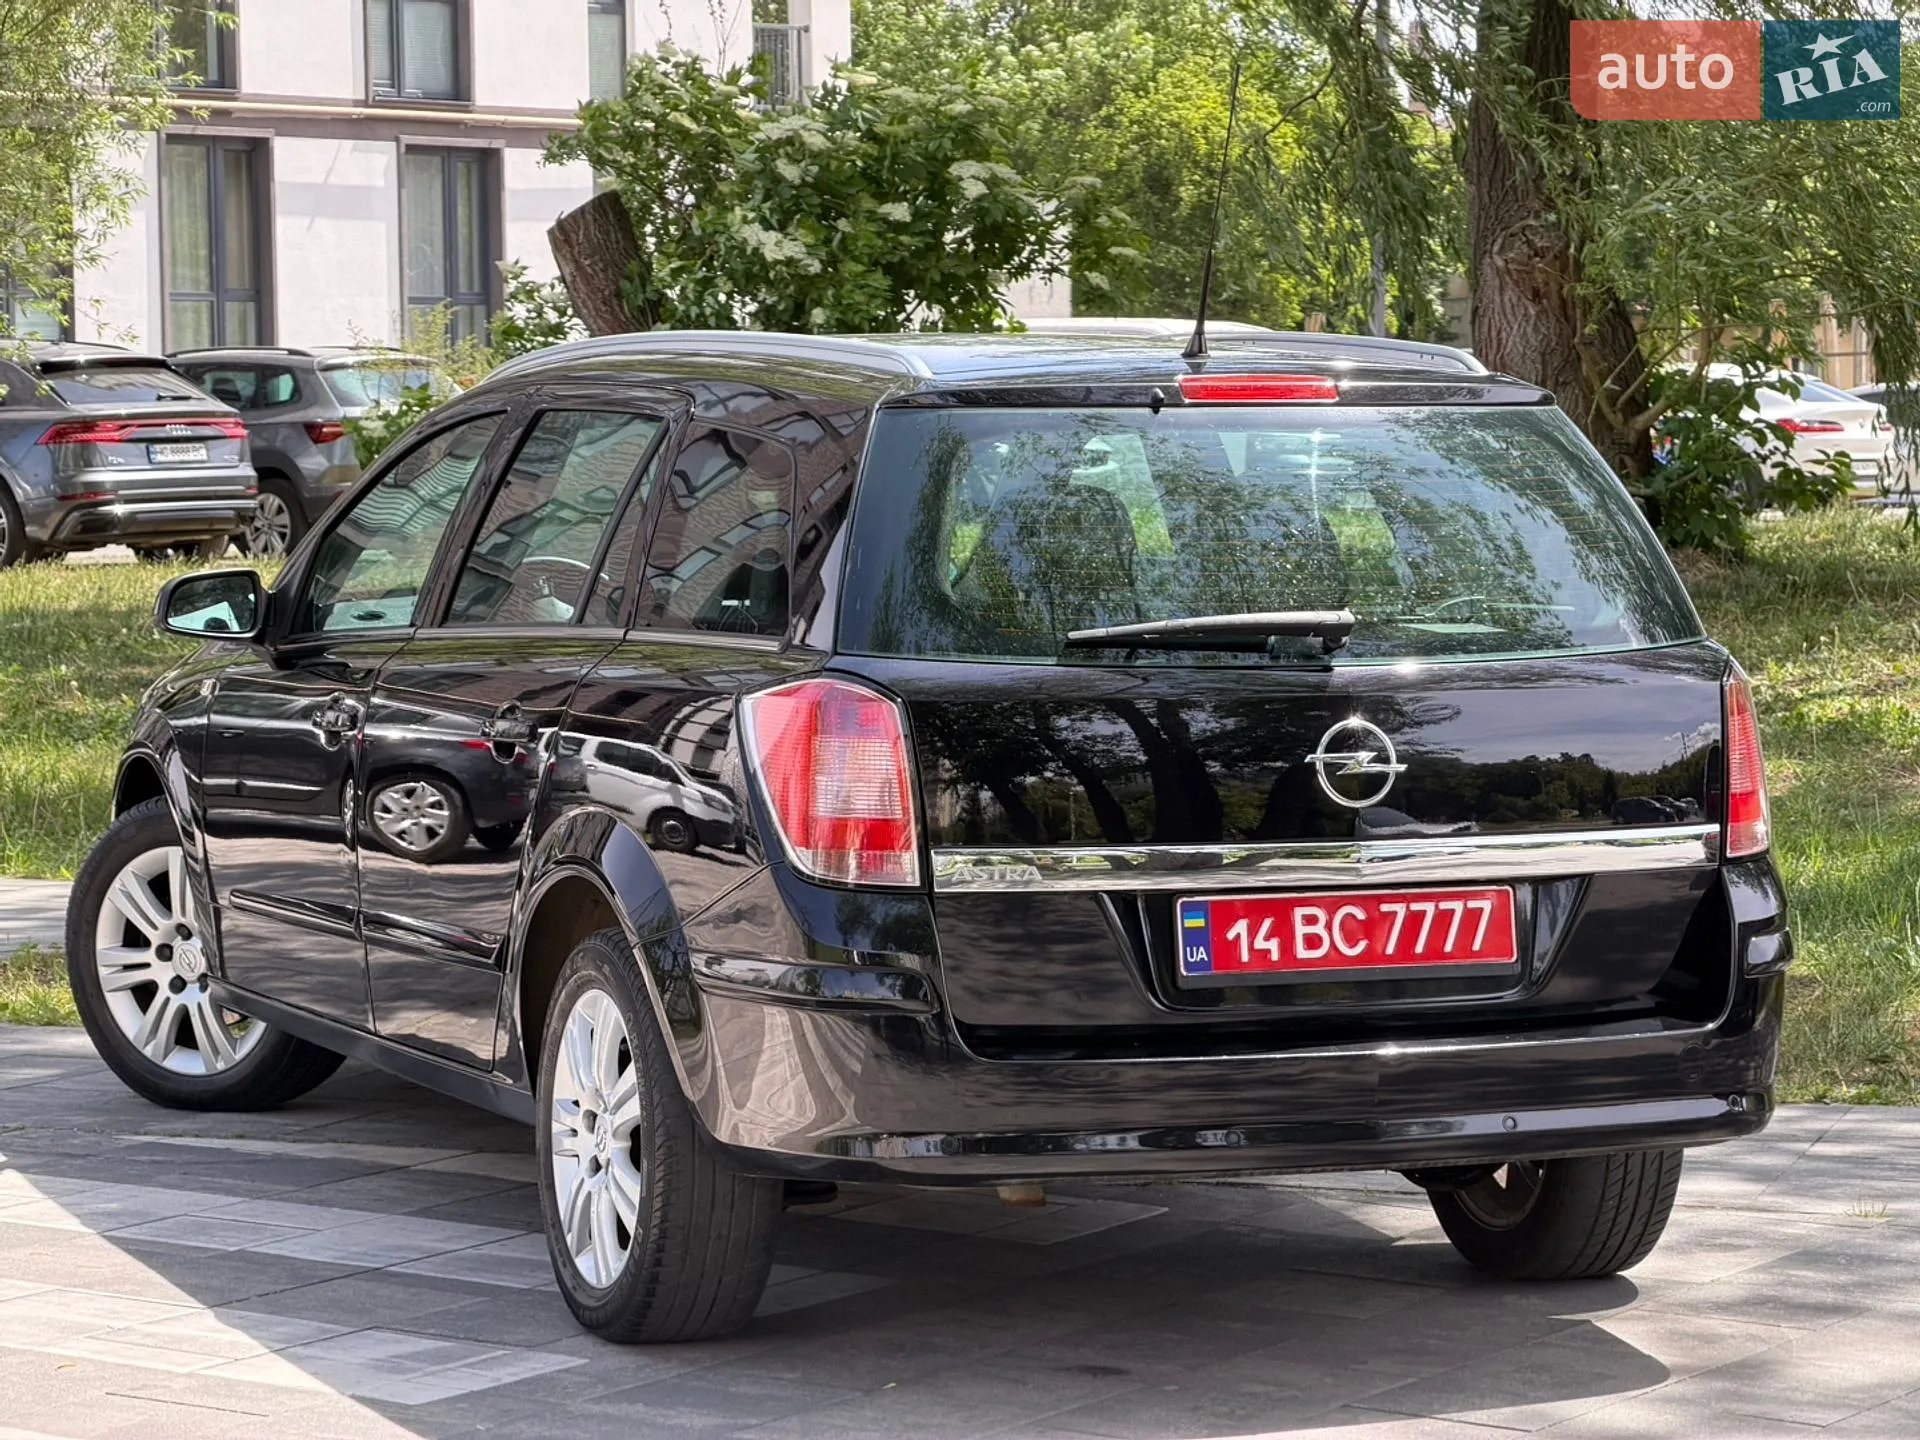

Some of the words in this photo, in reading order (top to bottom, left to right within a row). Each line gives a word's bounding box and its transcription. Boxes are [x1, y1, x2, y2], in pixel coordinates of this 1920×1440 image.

[951, 865, 1043, 881] ASTRA
[1225, 916, 1280, 963] 14
[1293, 904, 1370, 959] BC
[1379, 900, 1492, 955] 7777
[1186, 946, 1208, 962] UA
